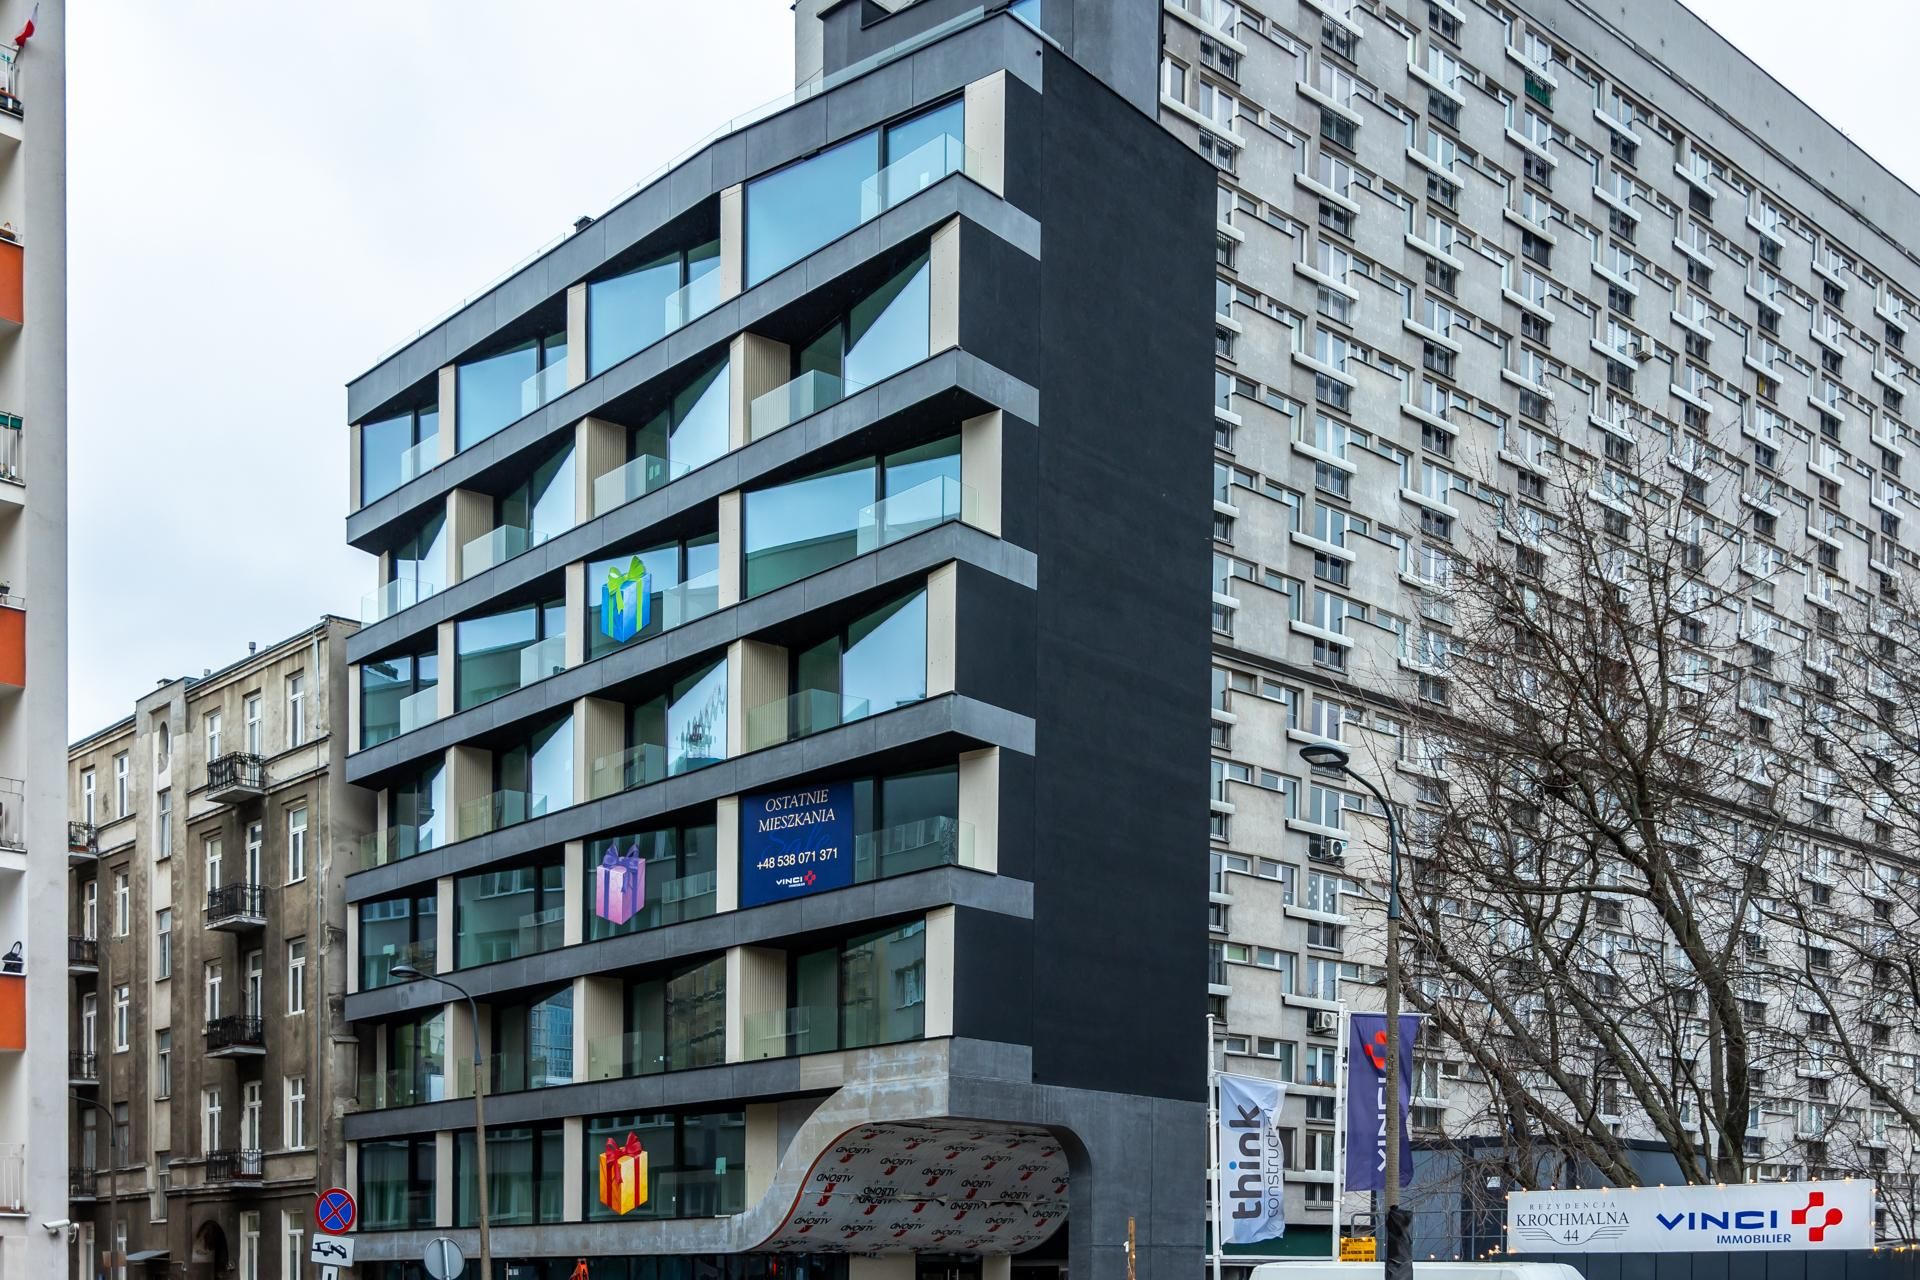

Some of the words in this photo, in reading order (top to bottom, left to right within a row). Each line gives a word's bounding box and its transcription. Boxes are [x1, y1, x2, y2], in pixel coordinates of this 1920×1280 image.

[765, 789, 829, 812] OSTATNIE
[758, 808, 836, 832] MIESZKANIA
[756, 857, 775, 870] +48
[777, 853, 796, 867] 538
[798, 850, 816, 864] 071
[819, 847, 838, 861] 371
[775, 876, 803, 885] VINCI
[836, 1146, 874, 1154] ALBOND
[880, 1157, 917, 1165] ALBOND
[1228, 1104, 1263, 1219] think
[922, 1167, 958, 1176] ALBOND
[816, 1173, 854, 1183] ALBOND
[961, 1179, 994, 1188] ALBOND
[863, 1187, 898, 1196] ALBOND
[1000, 1191, 1031, 1199] ALBOND
[951, 1201, 982, 1210] ALBOND
[1528, 1201, 1617, 1211] REZYDENCJA
[1516, 1211, 1630, 1227] KROCHMALNA
[1656, 1210, 1777, 1231] VINCI
[1563, 1229, 1579, 1242] 44
[1716, 1233, 1792, 1245] IMMOBILIER
